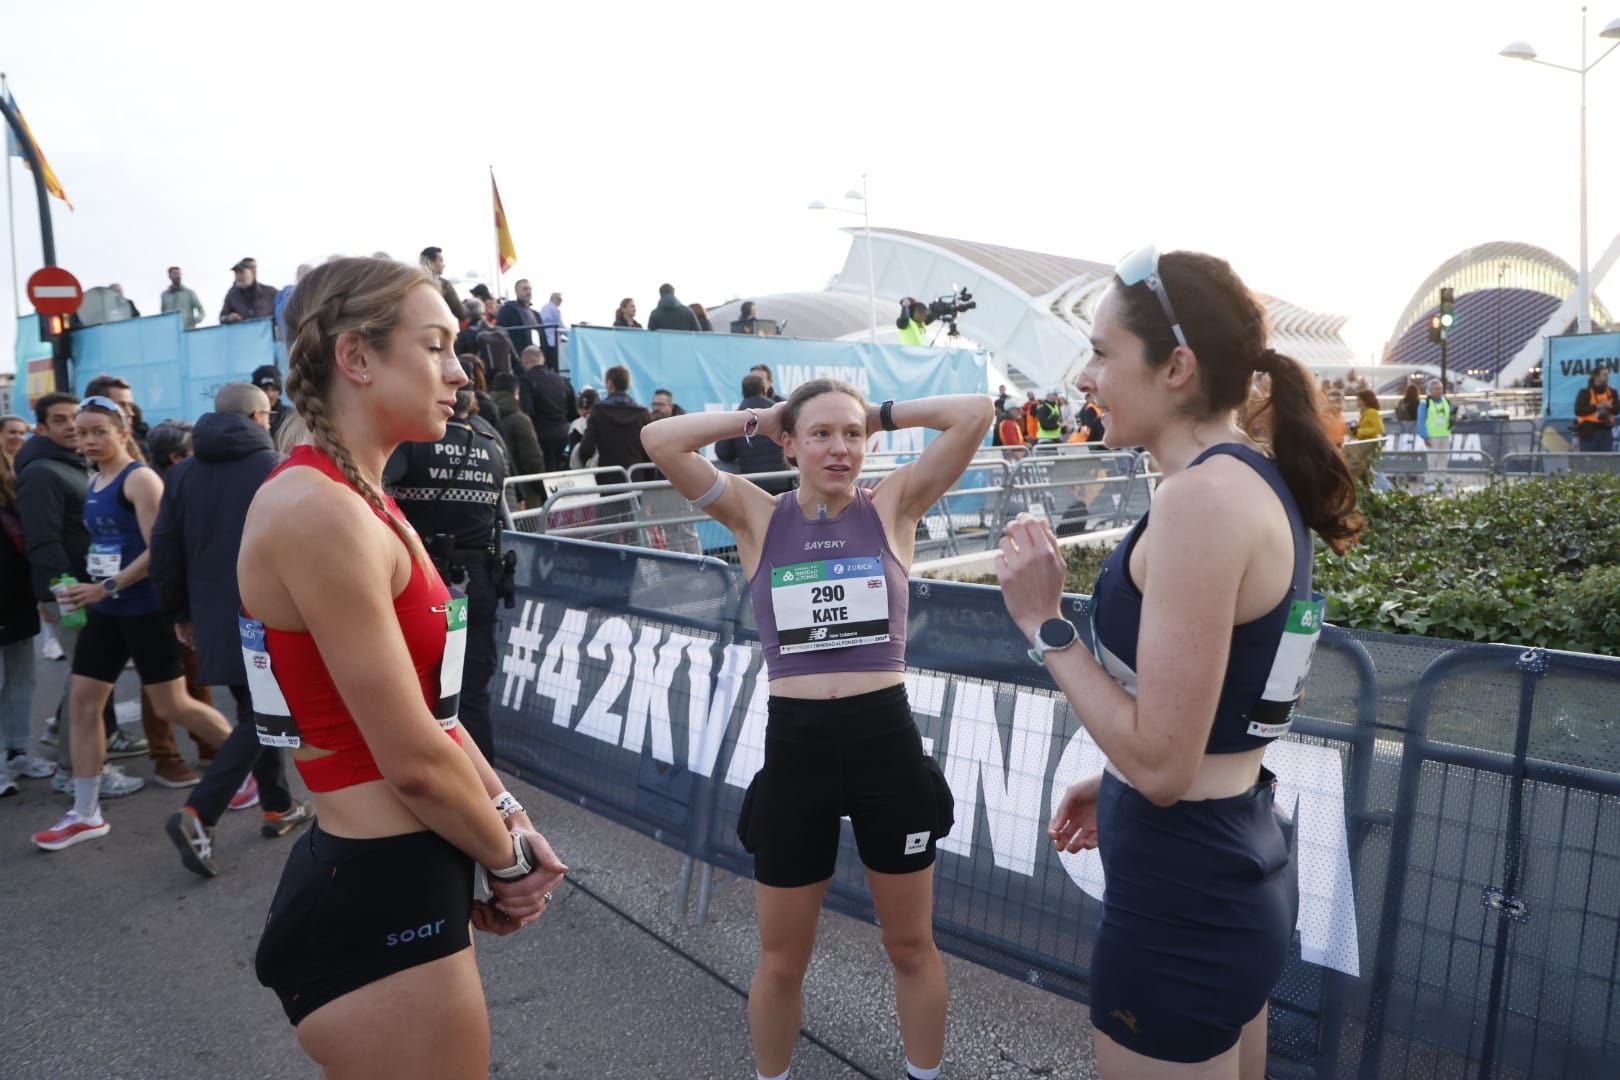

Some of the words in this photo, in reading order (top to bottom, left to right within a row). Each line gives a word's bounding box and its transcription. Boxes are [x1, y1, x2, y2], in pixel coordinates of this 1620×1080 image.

[449, 456, 480, 467] LOAL
[803, 540, 846, 551] SAYSKY
[847, 564, 873, 572] ZURICH
[811, 585, 845, 604] 290
[812, 606, 849, 624] KATE
[386, 918, 445, 946] soar
